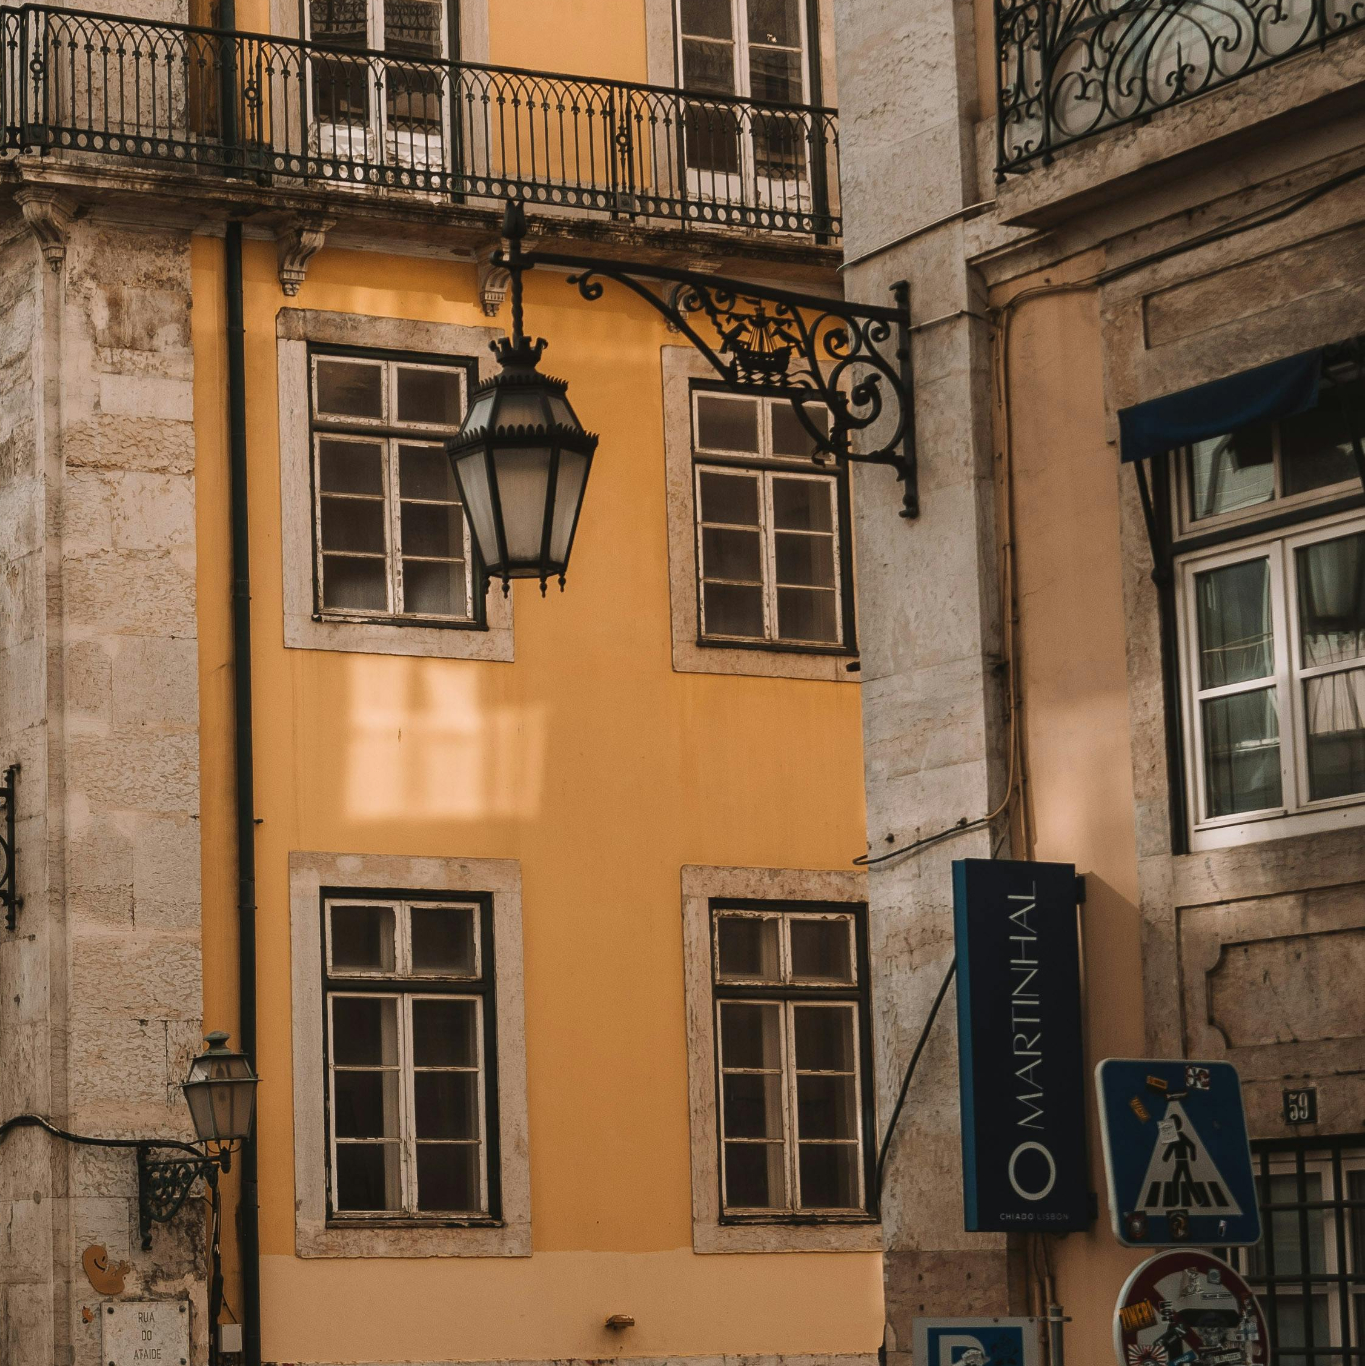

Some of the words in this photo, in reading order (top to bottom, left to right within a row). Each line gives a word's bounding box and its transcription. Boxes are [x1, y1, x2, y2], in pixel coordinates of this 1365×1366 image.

[1006, 879, 1045, 1130] MARTINHAL
[1288, 1092, 1309, 1121] 59
[999, 1212, 1034, 1221] CHIADO
[1036, 1212, 1069, 1221] LISBON
[137, 1311, 156, 1323] RUA
[141, 1330, 153, 1341] DO
